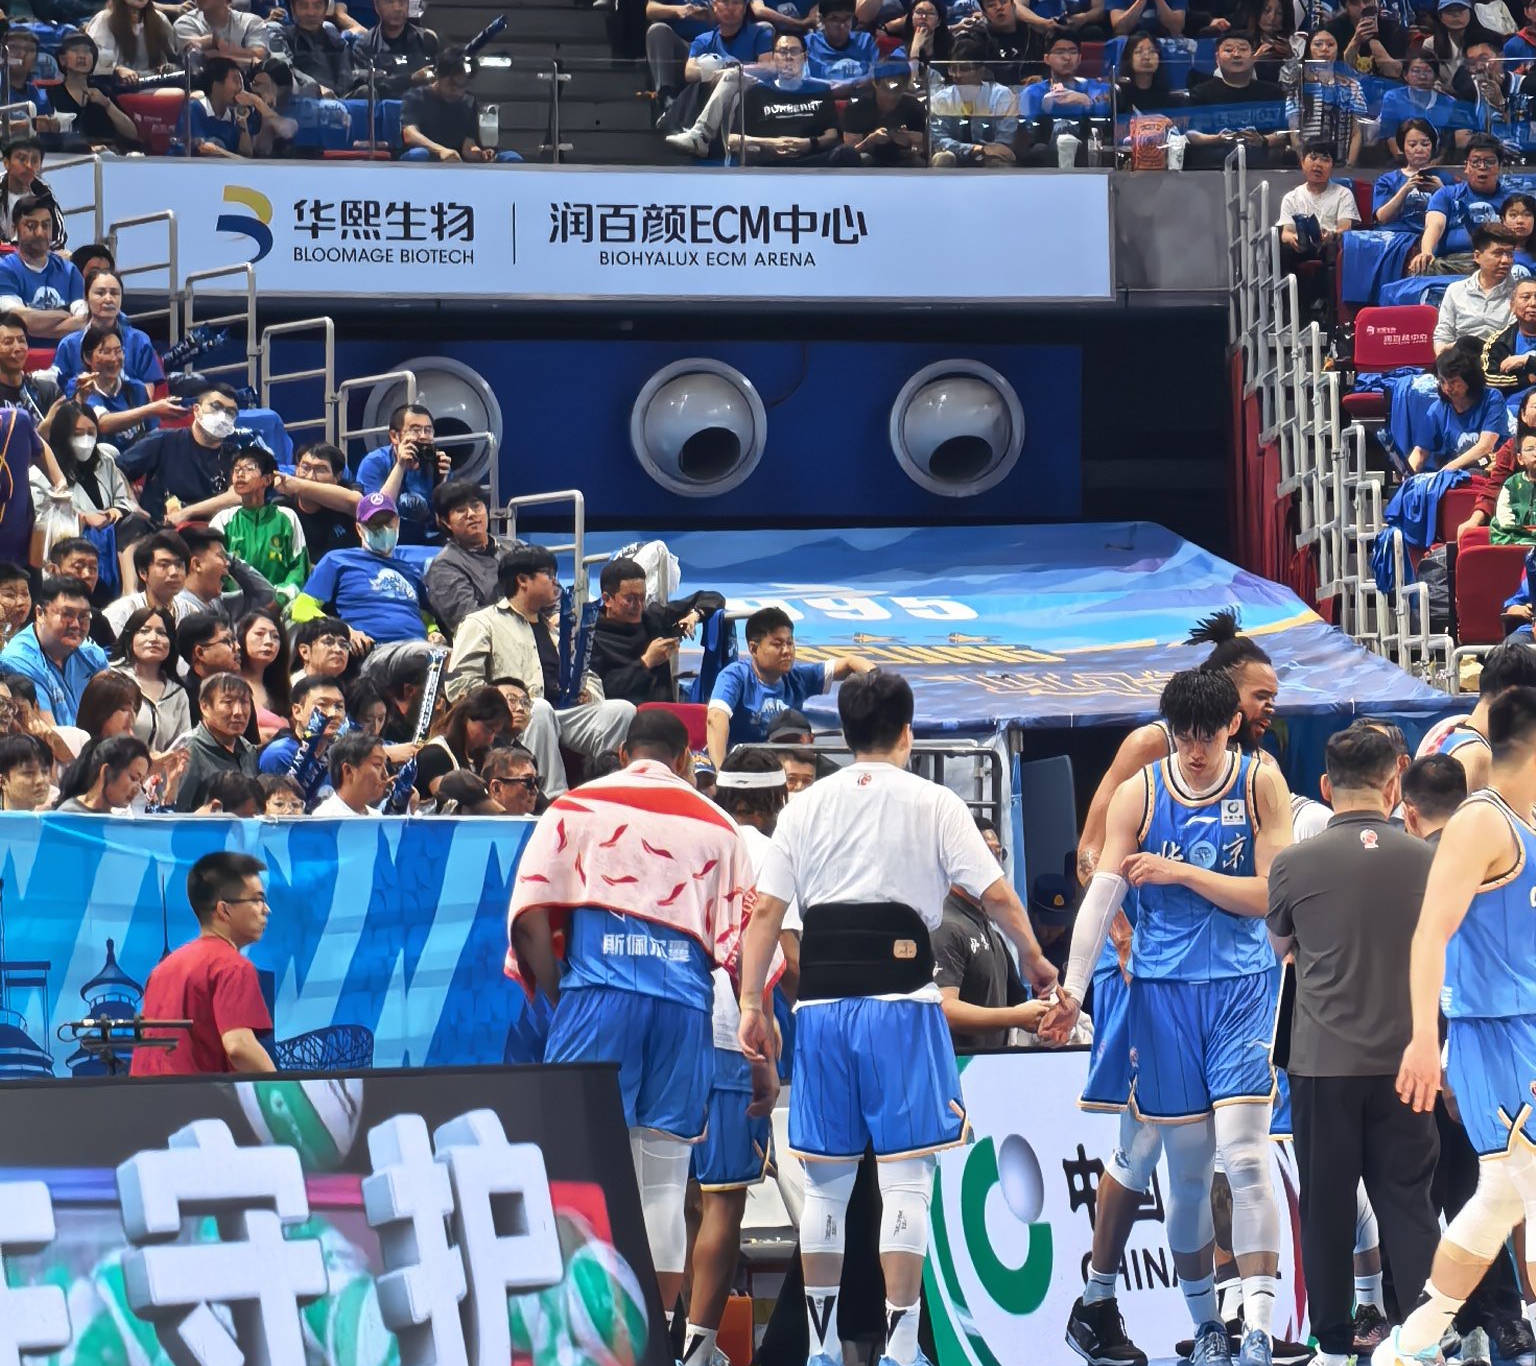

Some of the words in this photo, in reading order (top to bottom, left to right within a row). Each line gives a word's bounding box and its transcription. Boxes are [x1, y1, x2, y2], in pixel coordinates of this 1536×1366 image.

[293, 199, 475, 243] 华熙生物
[549, 201, 868, 245] 润百颜ECM中心
[293, 246, 394, 265] BLOOMAGE
[401, 247, 474, 266] BIOTECH
[600, 250, 699, 268] BIOHYALUX
[705, 250, 747, 268] ECM
[754, 251, 816, 268] ARENA
